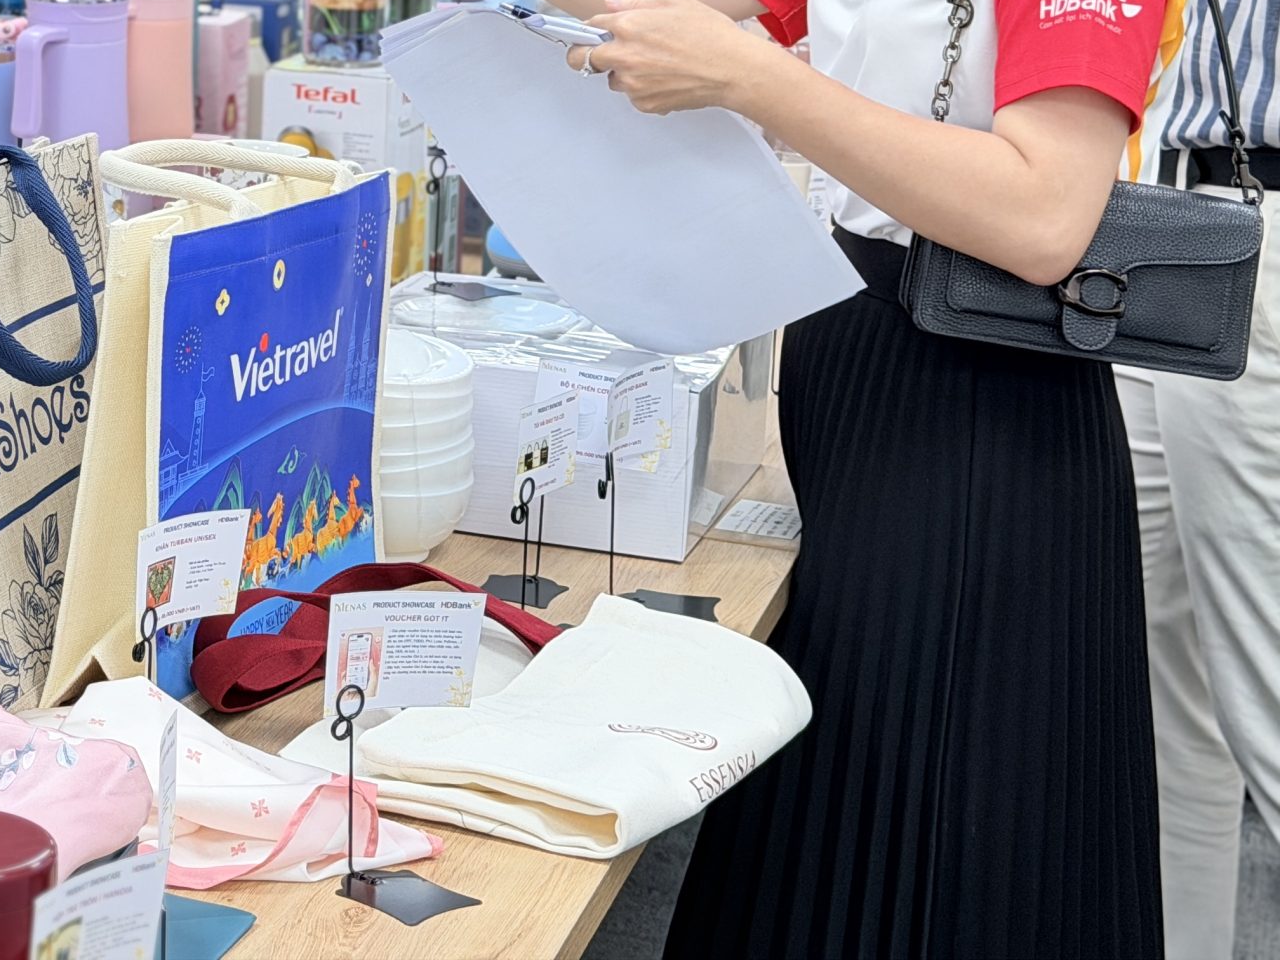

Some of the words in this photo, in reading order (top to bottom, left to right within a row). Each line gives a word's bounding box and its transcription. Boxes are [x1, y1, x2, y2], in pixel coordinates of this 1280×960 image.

[291, 83, 360, 105] Tefal
[230, 318, 340, 402] Vietravel
[275, 601, 294, 626] YEAR
